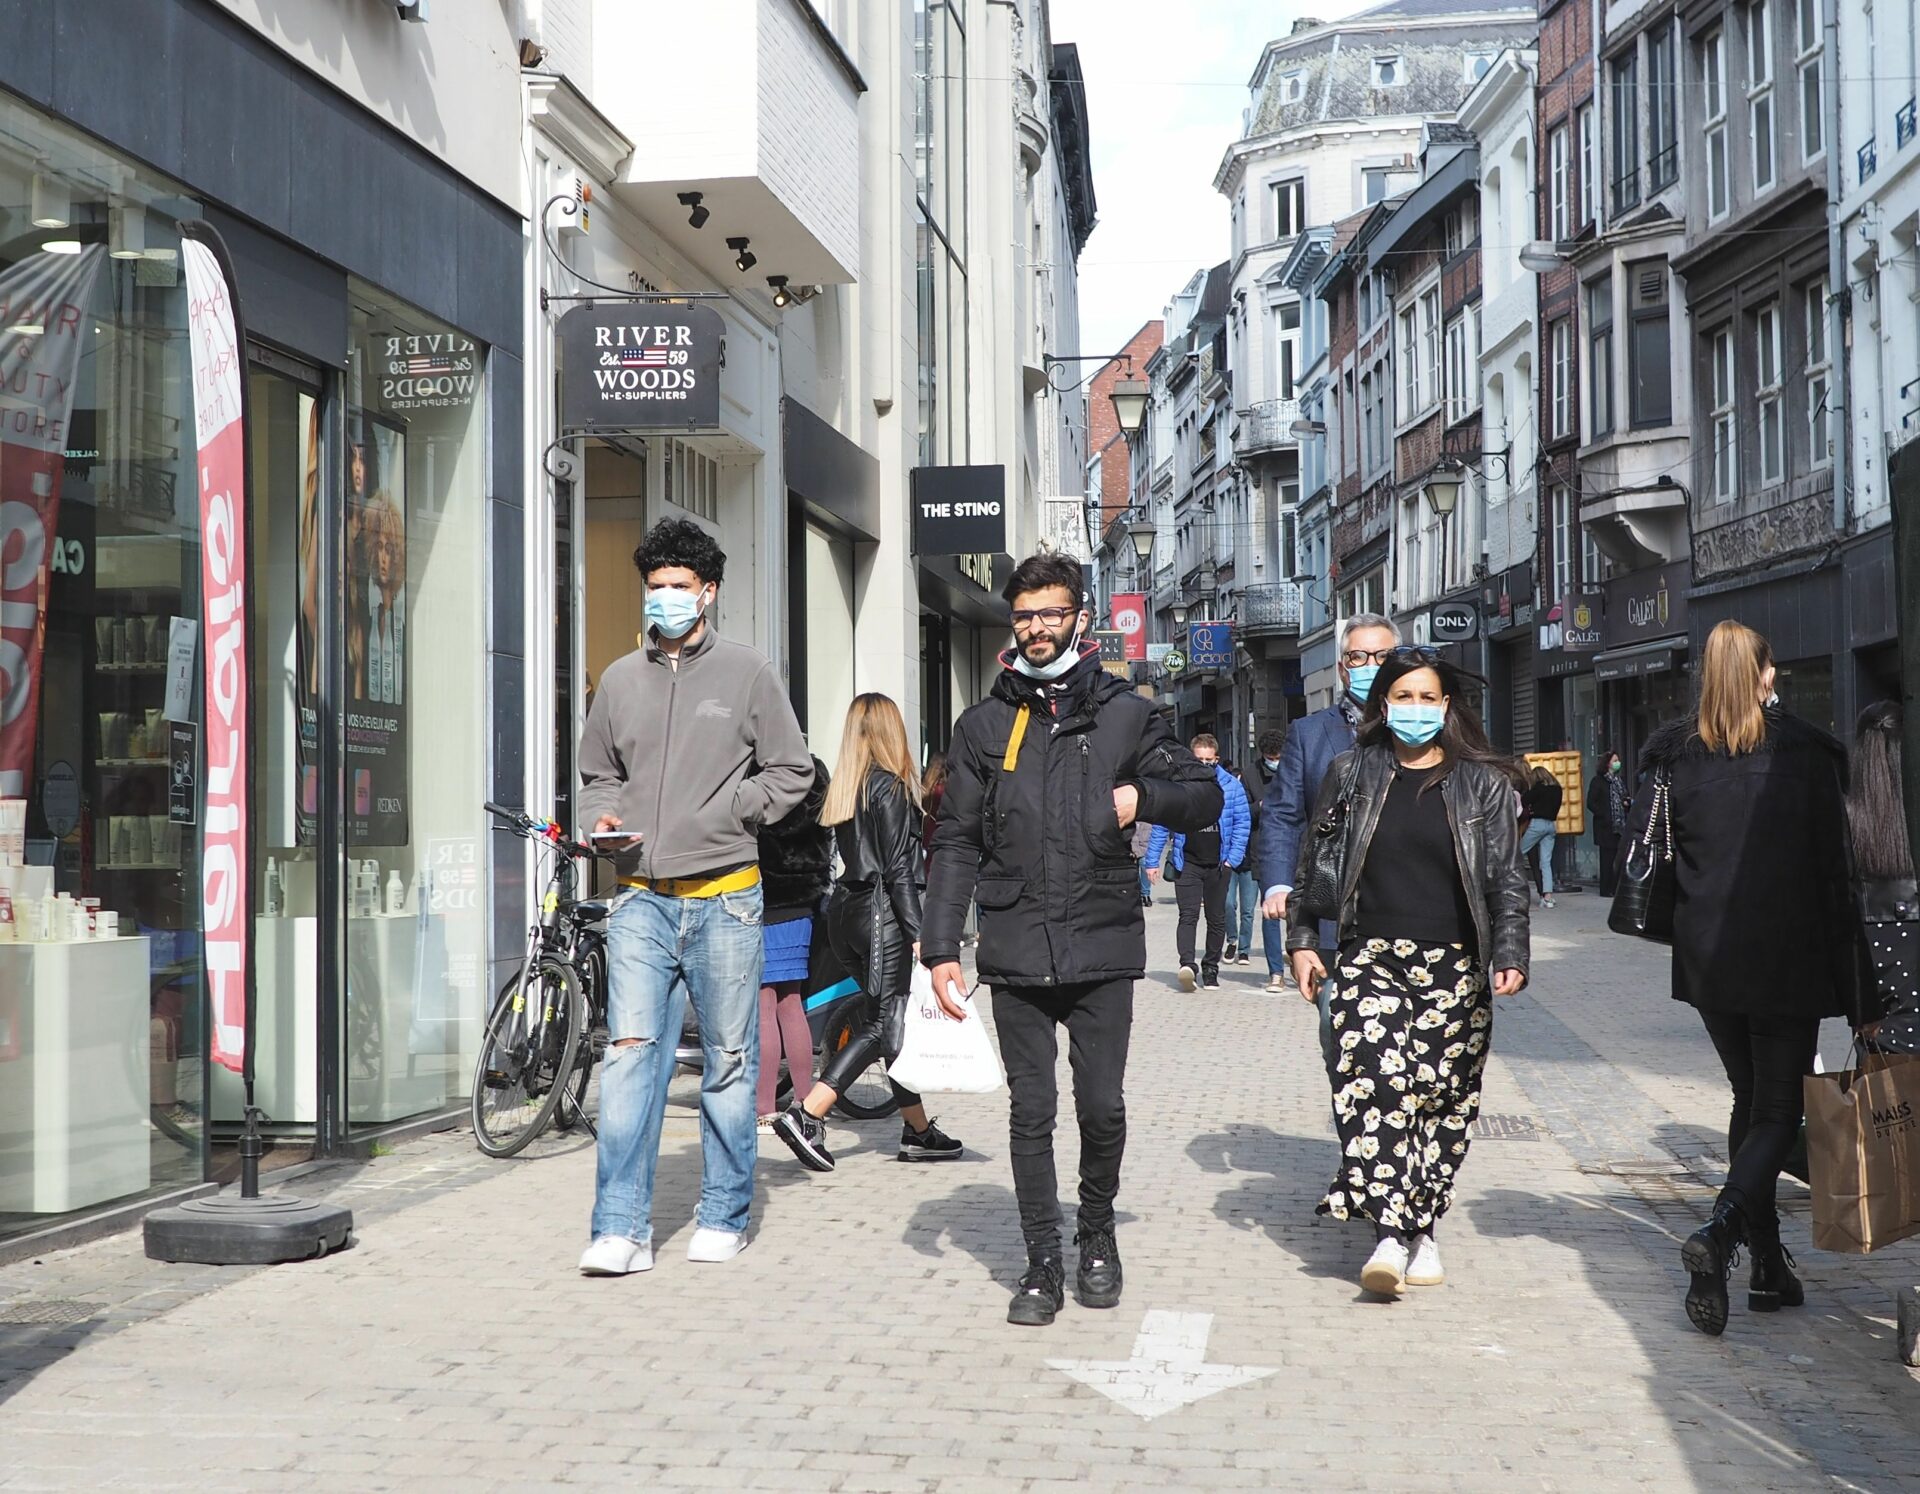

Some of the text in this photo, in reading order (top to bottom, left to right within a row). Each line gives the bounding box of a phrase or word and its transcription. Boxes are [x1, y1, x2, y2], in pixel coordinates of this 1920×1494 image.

[595, 326, 693, 346] RIVER
[668, 350, 688, 365] 59
[593, 369, 696, 389] WOODS
[921, 501, 1001, 518] THE STING
[1628, 594, 1655, 624] GALÉT
[1120, 616, 1137, 627] di!
[1435, 616, 1473, 627] ONLY
[1566, 630, 1600, 643] GALÉT
